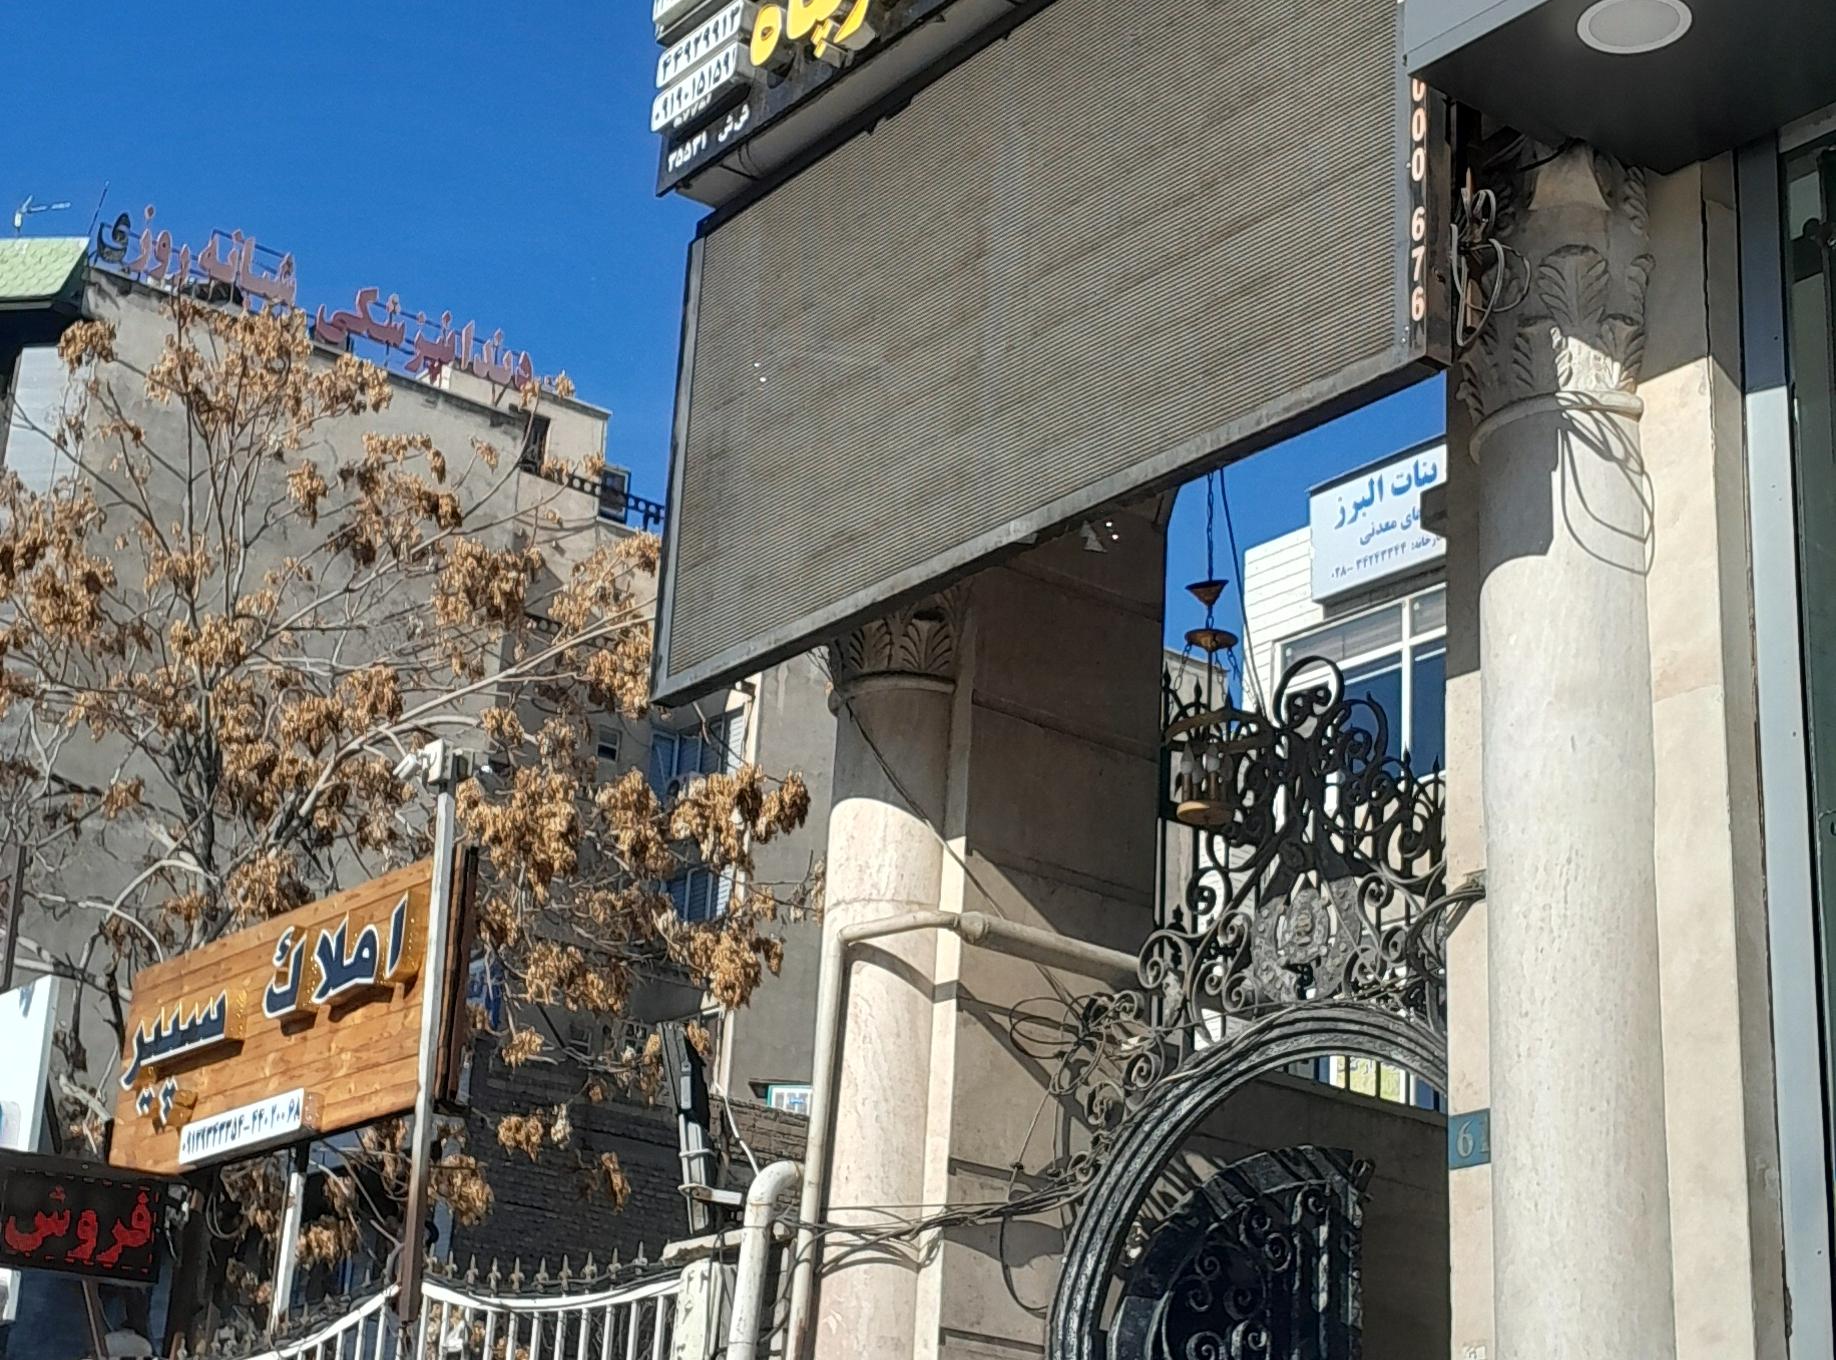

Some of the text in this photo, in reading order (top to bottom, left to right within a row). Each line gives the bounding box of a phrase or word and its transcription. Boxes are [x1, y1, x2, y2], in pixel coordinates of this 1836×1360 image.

[1333, 474, 1386, 530] البرز
[1359, 519, 1397, 546] معدنی
[5, 1186, 153, 1266] فروش
